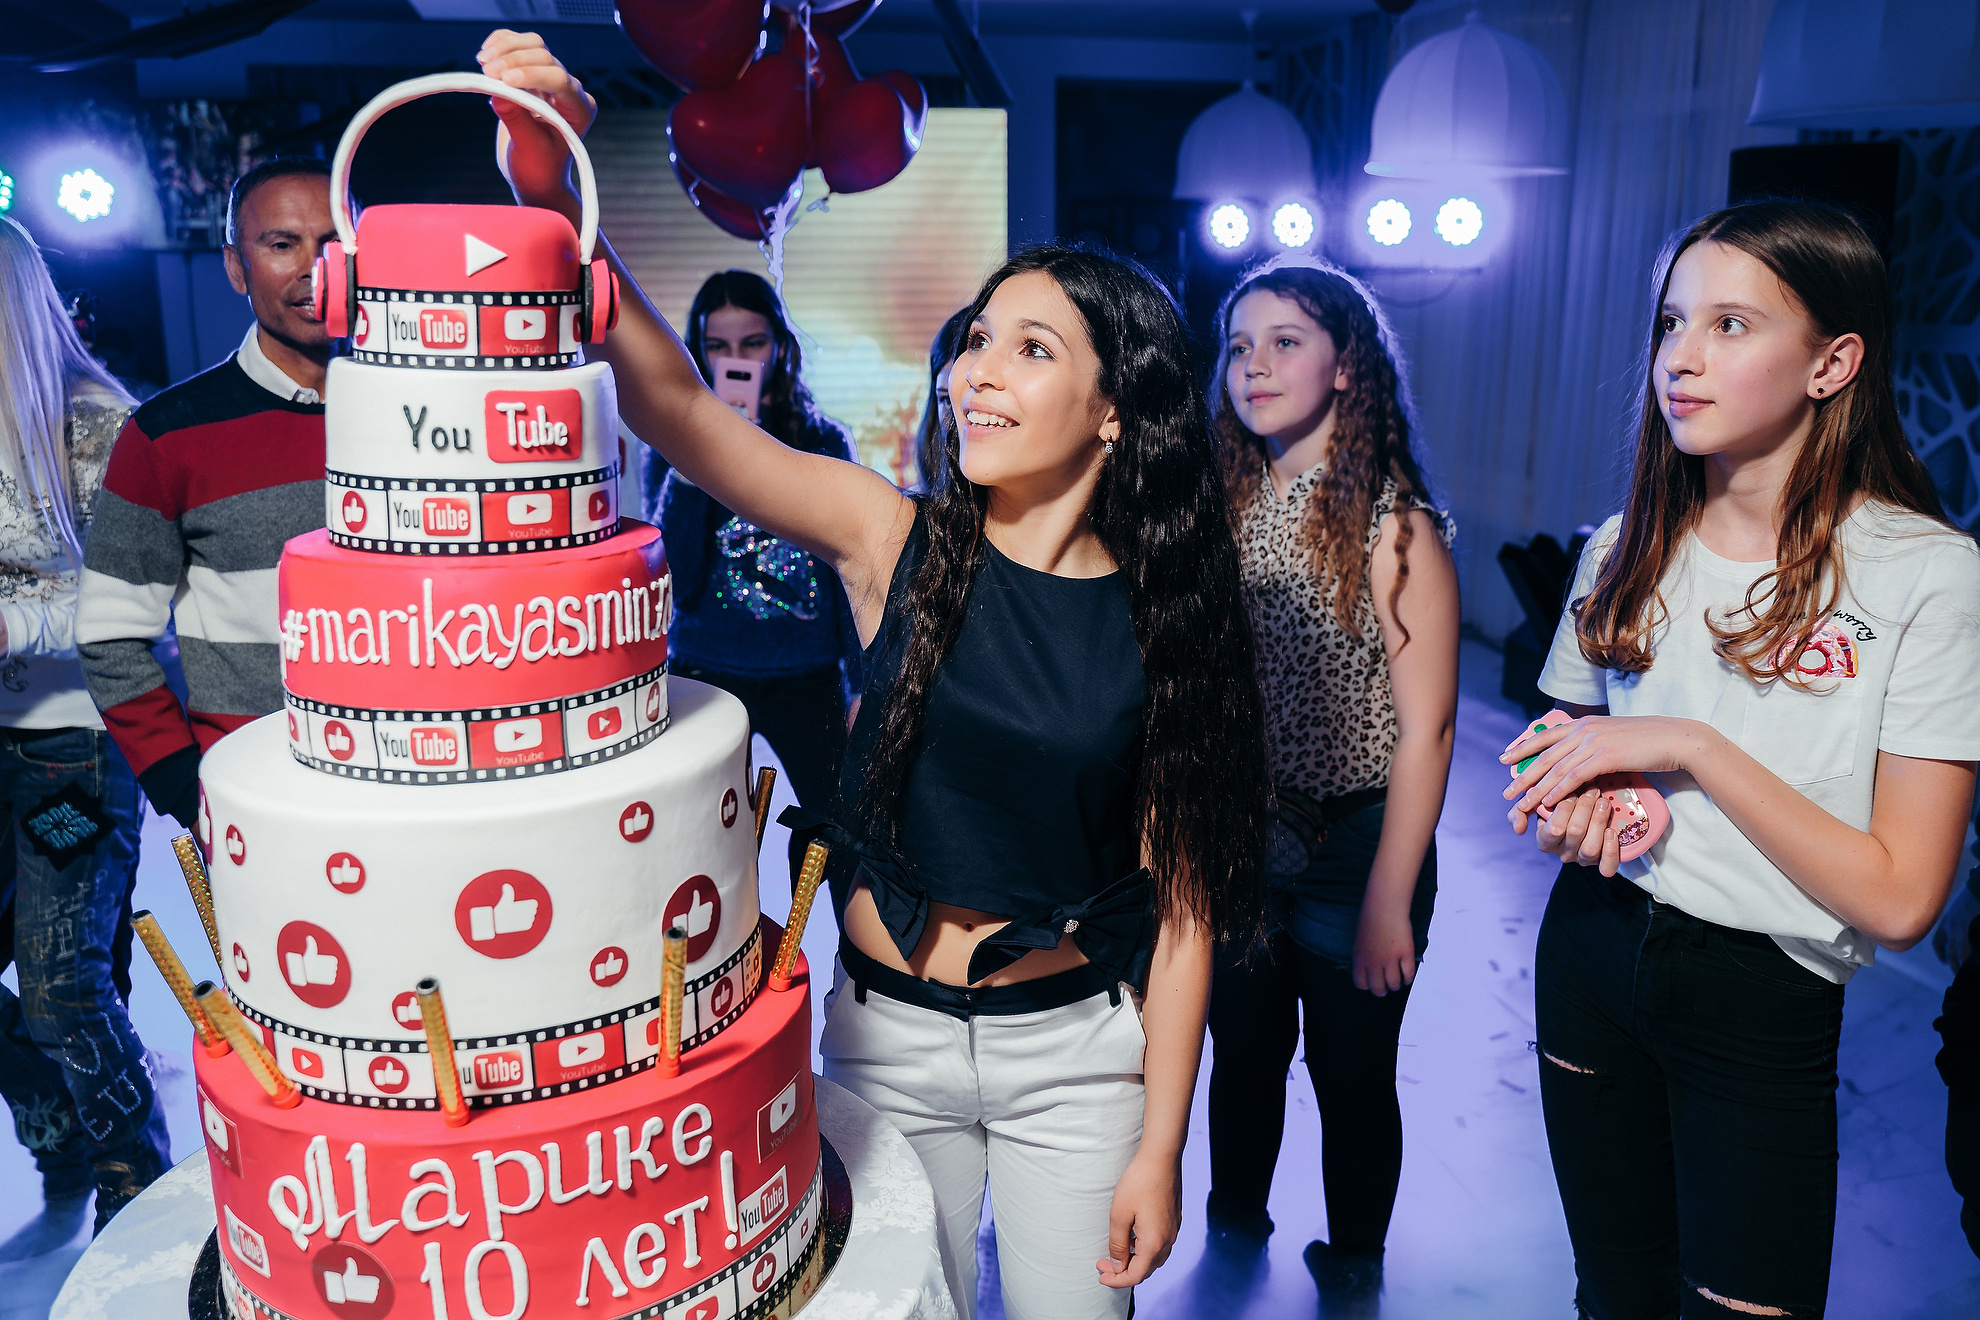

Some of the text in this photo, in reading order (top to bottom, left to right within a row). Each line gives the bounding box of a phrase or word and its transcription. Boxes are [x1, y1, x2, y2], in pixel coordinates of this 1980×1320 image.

[391, 312, 466, 344] You Tube
[504, 344, 546, 355] YouTube
[403, 402, 568, 450] You Tube
[393, 502, 469, 531] You Tube
[507, 527, 554, 539] YouTube
[1833, 610, 1877, 641] worry
[380, 731, 457, 762] You Tube
[495, 751, 544, 767] YouTube
[476, 1058, 521, 1084] Tube
[560, 1062, 607, 1080] YouTube
[769, 1118, 798, 1150] YouTube
[268, 1103, 713, 1251] Марике
[741, 1184, 784, 1233] You Tube
[420, 1239, 529, 1320] 10
